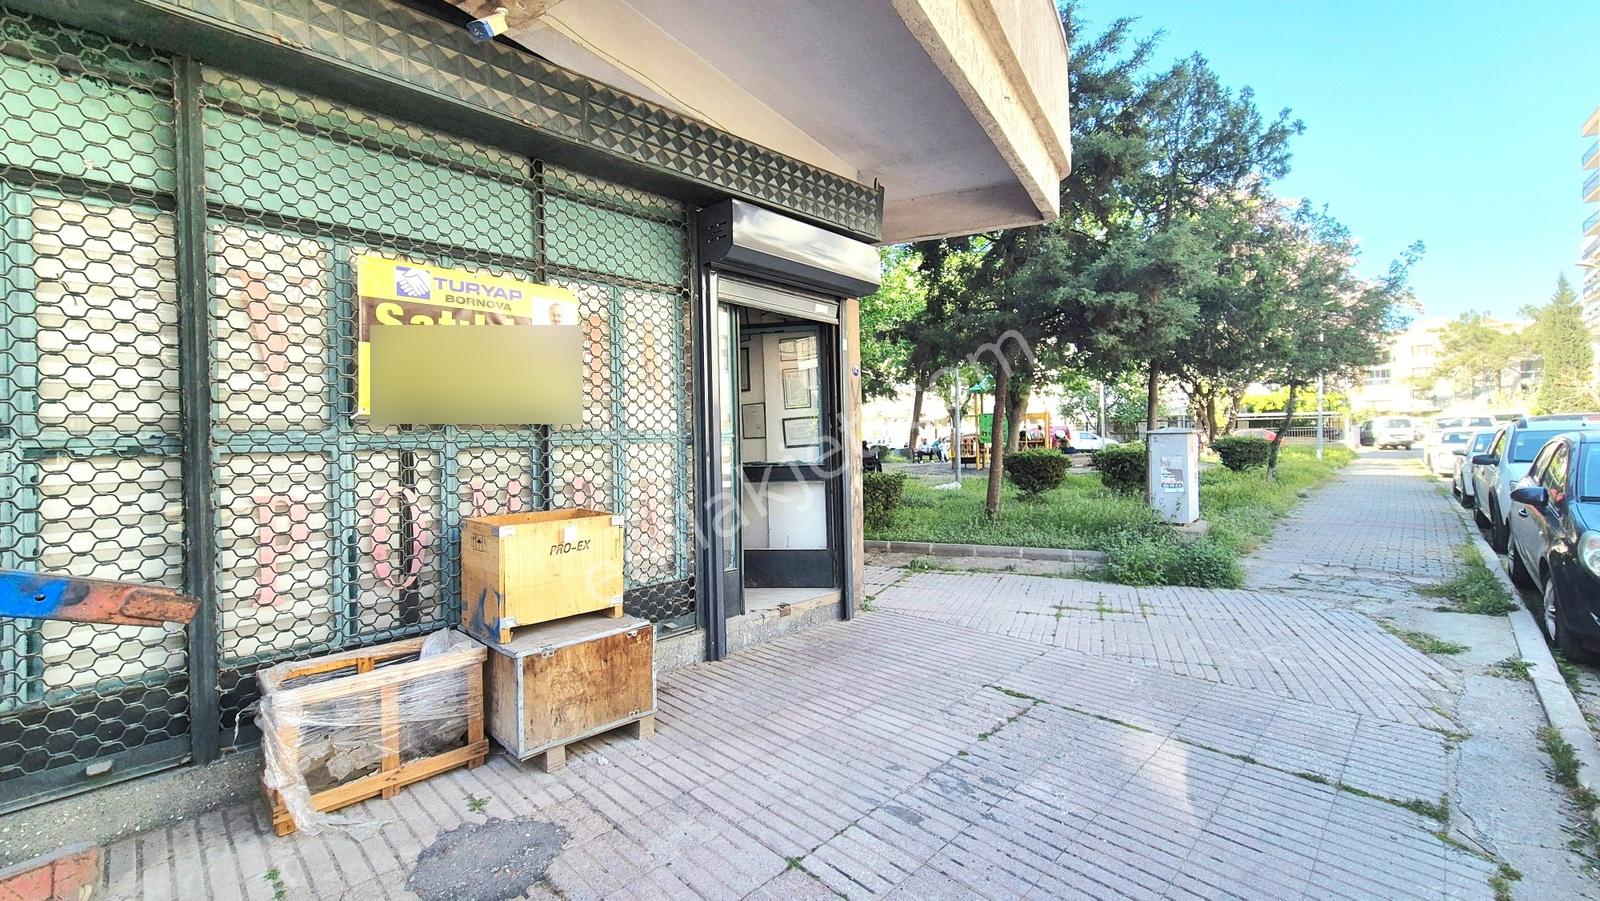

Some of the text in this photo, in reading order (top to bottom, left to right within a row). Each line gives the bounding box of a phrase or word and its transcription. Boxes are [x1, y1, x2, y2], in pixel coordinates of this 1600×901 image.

[433, 276, 522, 301] TURYAP
[445, 294, 512, 312] BORNOVA
[549, 539, 591, 556] PRO-EX
